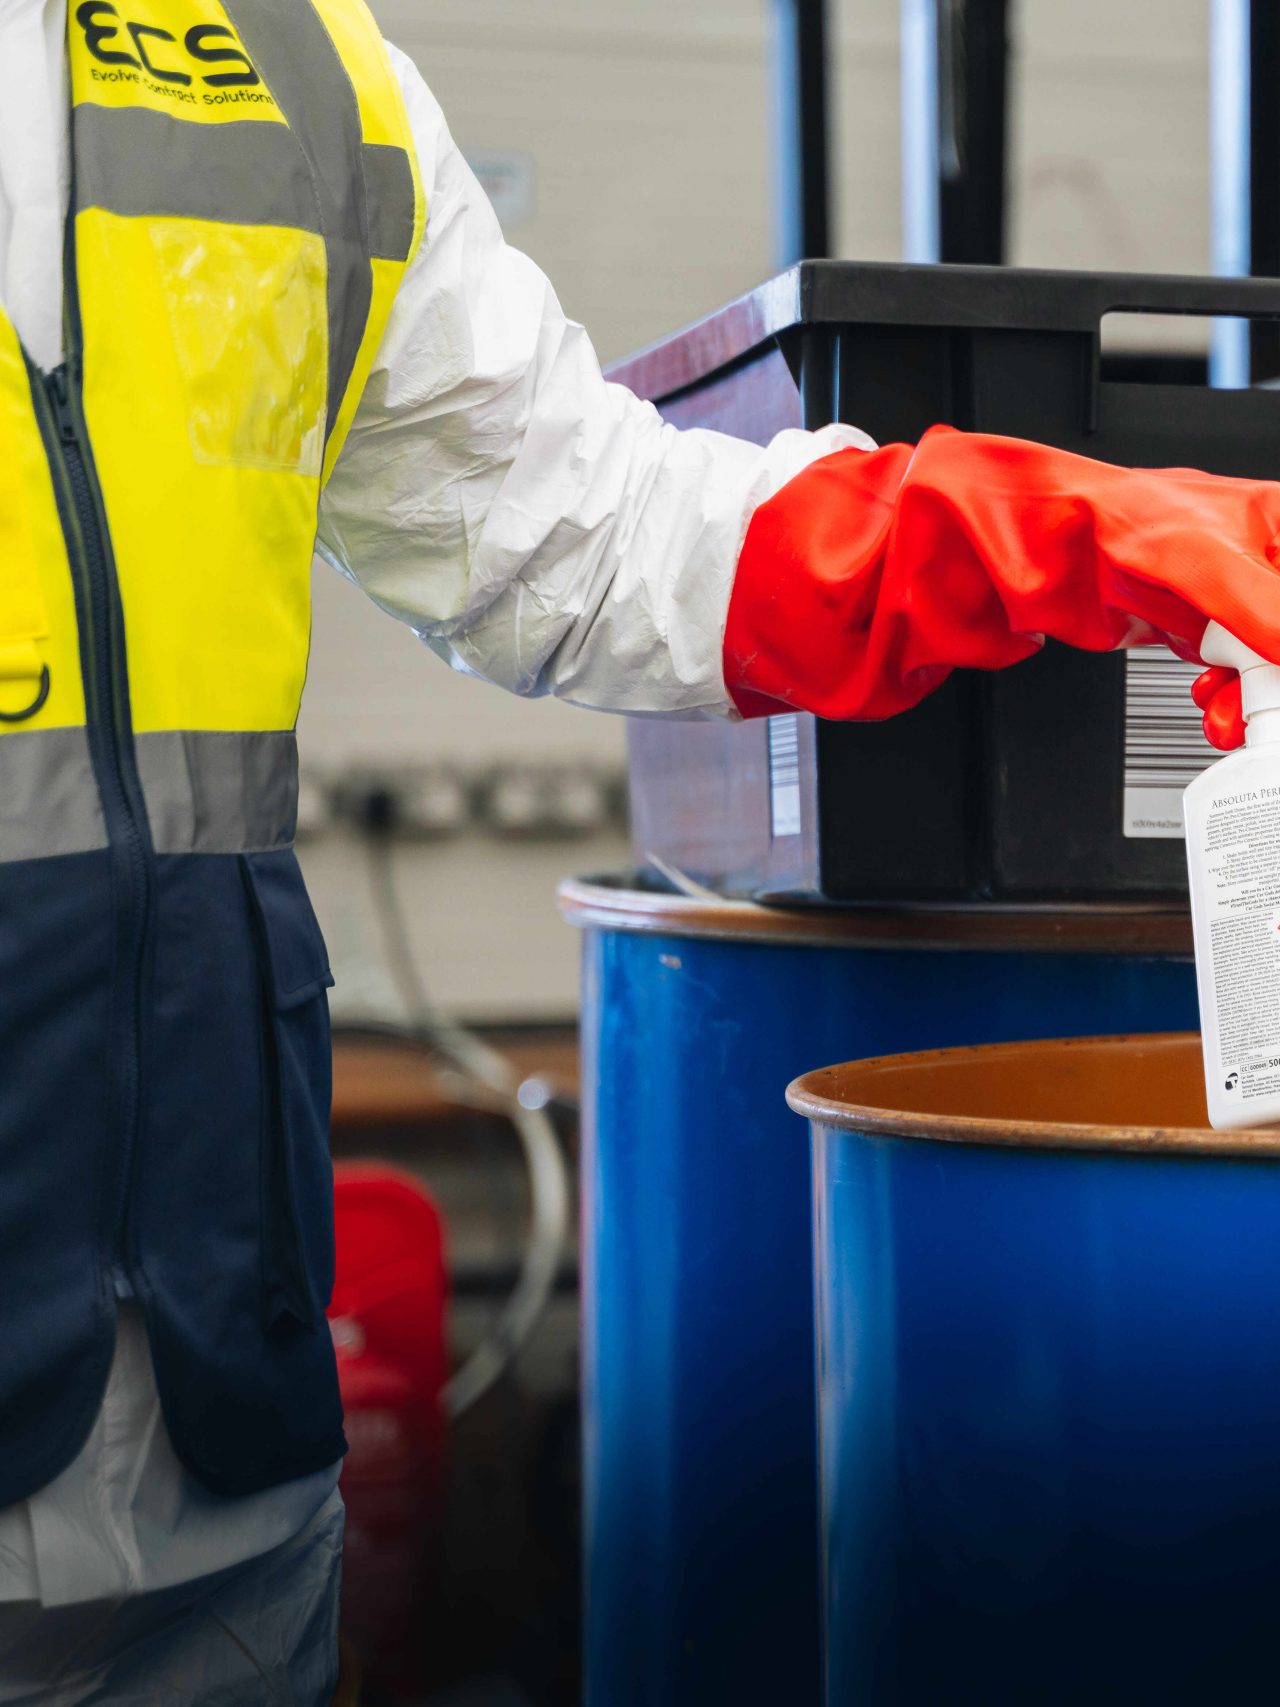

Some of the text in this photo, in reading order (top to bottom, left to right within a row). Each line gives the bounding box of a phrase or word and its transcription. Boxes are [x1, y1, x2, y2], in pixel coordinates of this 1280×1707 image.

[76, 1, 260, 87] ECS
[91, 68, 140, 83] Evolve
[1212, 792, 1257, 808] ABSOLUTA
